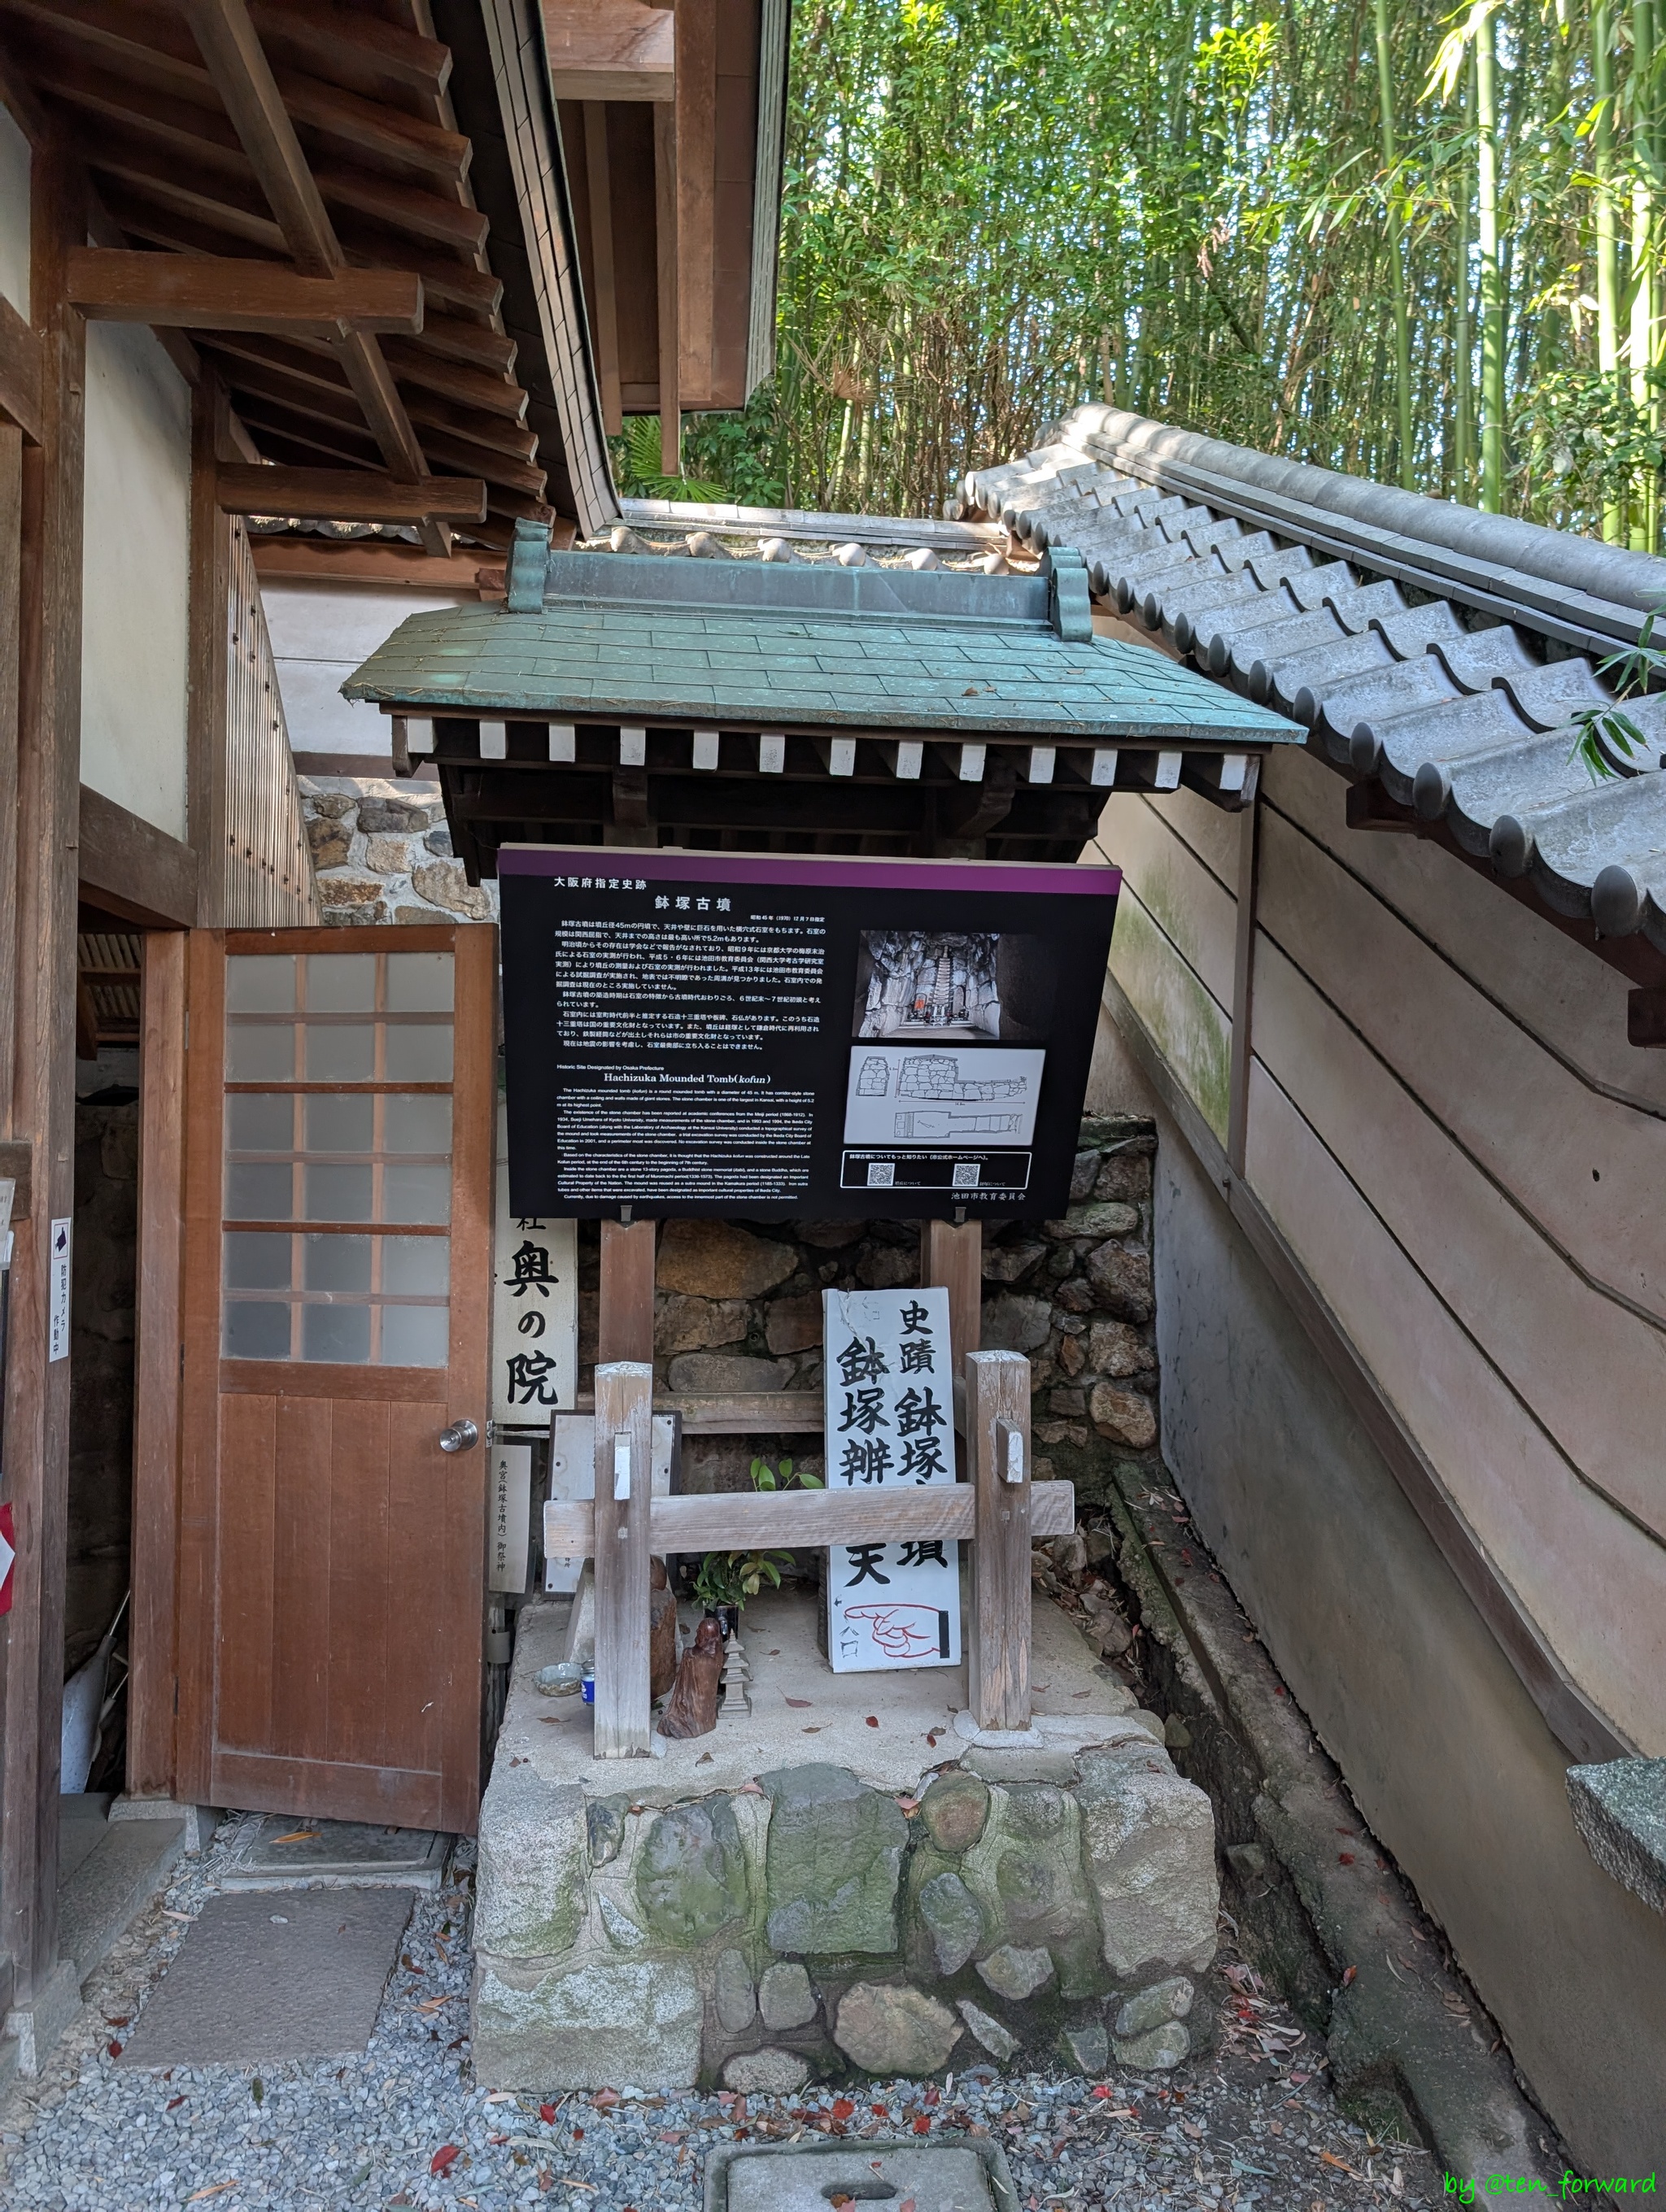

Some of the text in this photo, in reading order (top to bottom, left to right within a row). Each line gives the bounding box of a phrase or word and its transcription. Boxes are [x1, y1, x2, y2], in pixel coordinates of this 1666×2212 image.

[554, 877, 647, 890] 大阪府指定史跡
[655, 895, 731, 912] 鉢塚古墳
[604, 1073, 771, 1084] Hachizuka Mounded Tomb(kofun)
[951, 1192, 1026, 1201] 池田市教育委員会
[496, 1542, 507, 1572] 御祭神
